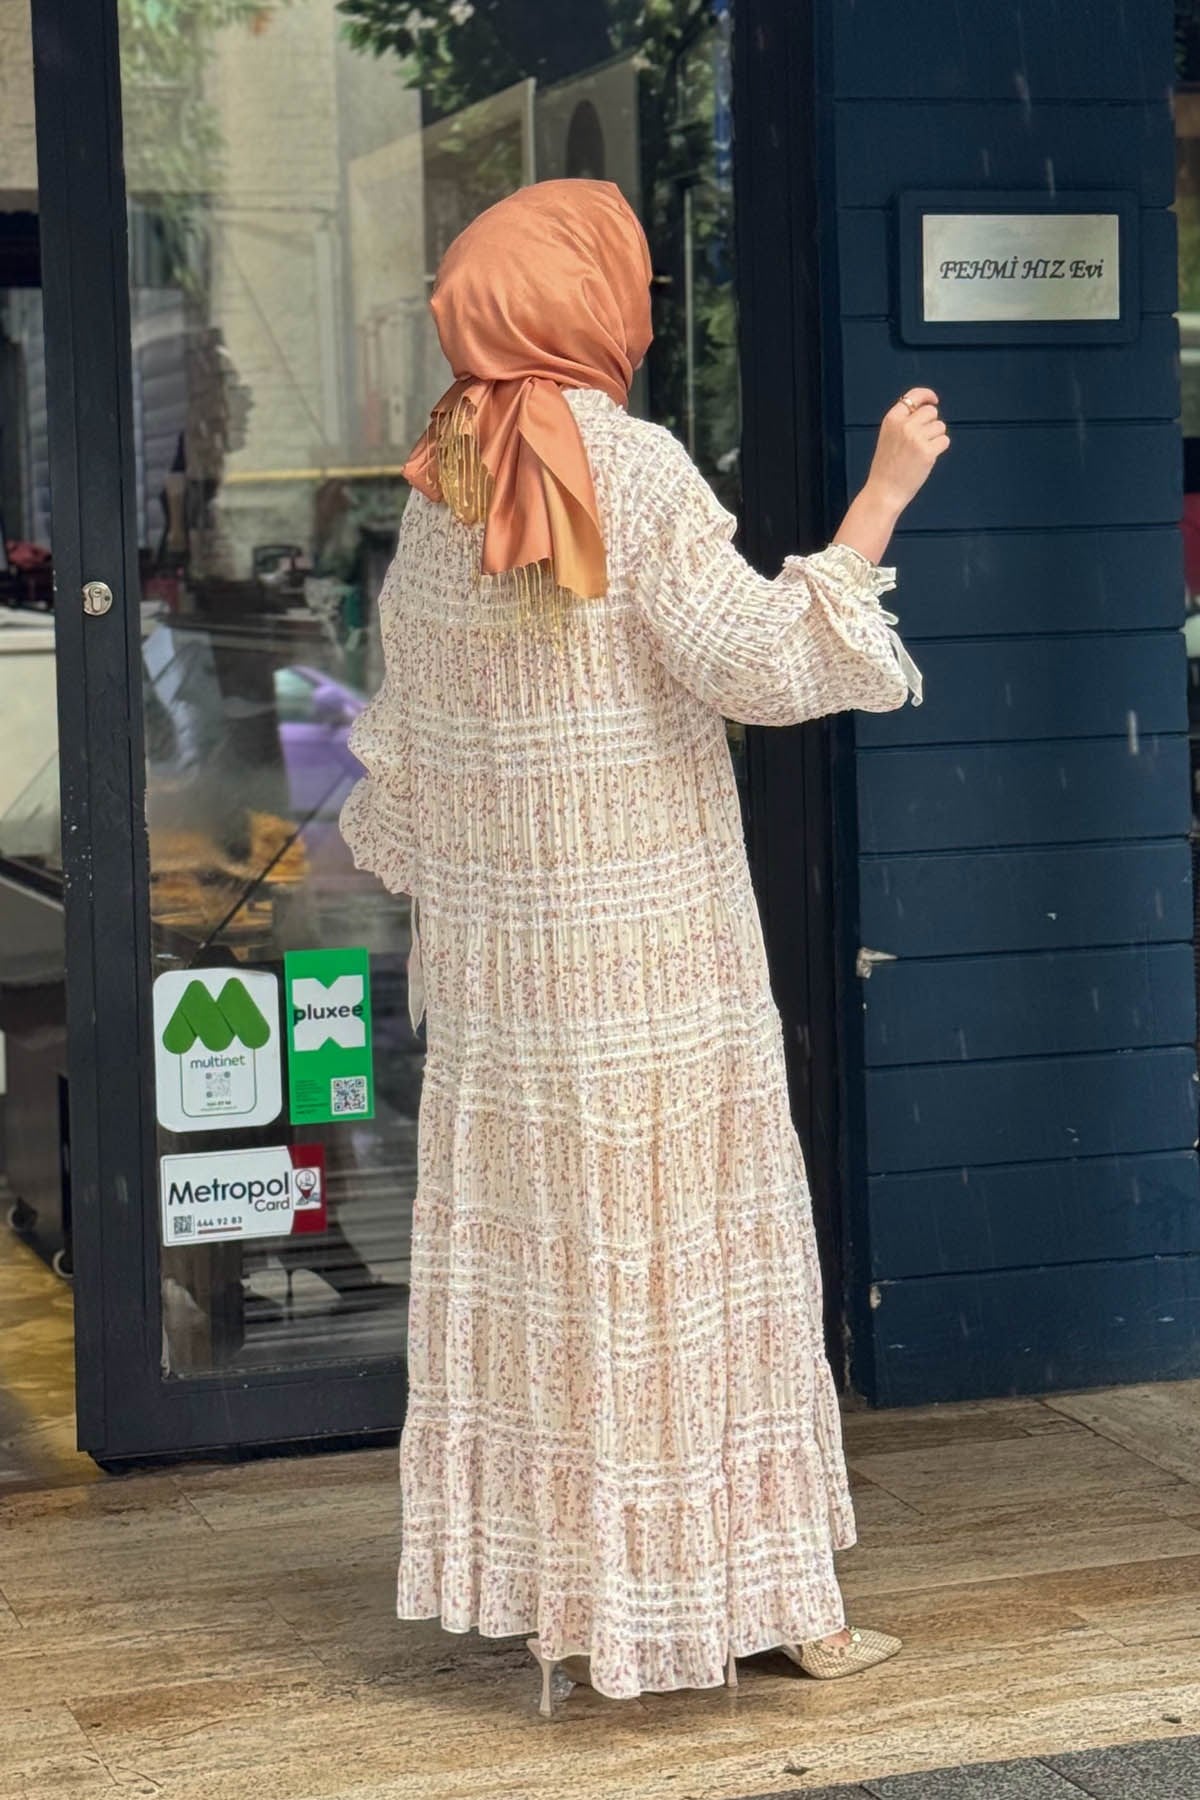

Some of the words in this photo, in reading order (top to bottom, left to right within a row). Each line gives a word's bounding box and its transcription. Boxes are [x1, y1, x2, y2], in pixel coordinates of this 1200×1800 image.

[940, 256, 1019, 280] FEHMİ
[1021, 259, 1065, 279] HIZ
[1069, 259, 1104, 279] Evi
[294, 1004, 364, 1026] pluxee
[190, 1054, 246, 1069] multinet
[168, 1171, 290, 1206] Metropol
[254, 1197, 290, 1212] Card
